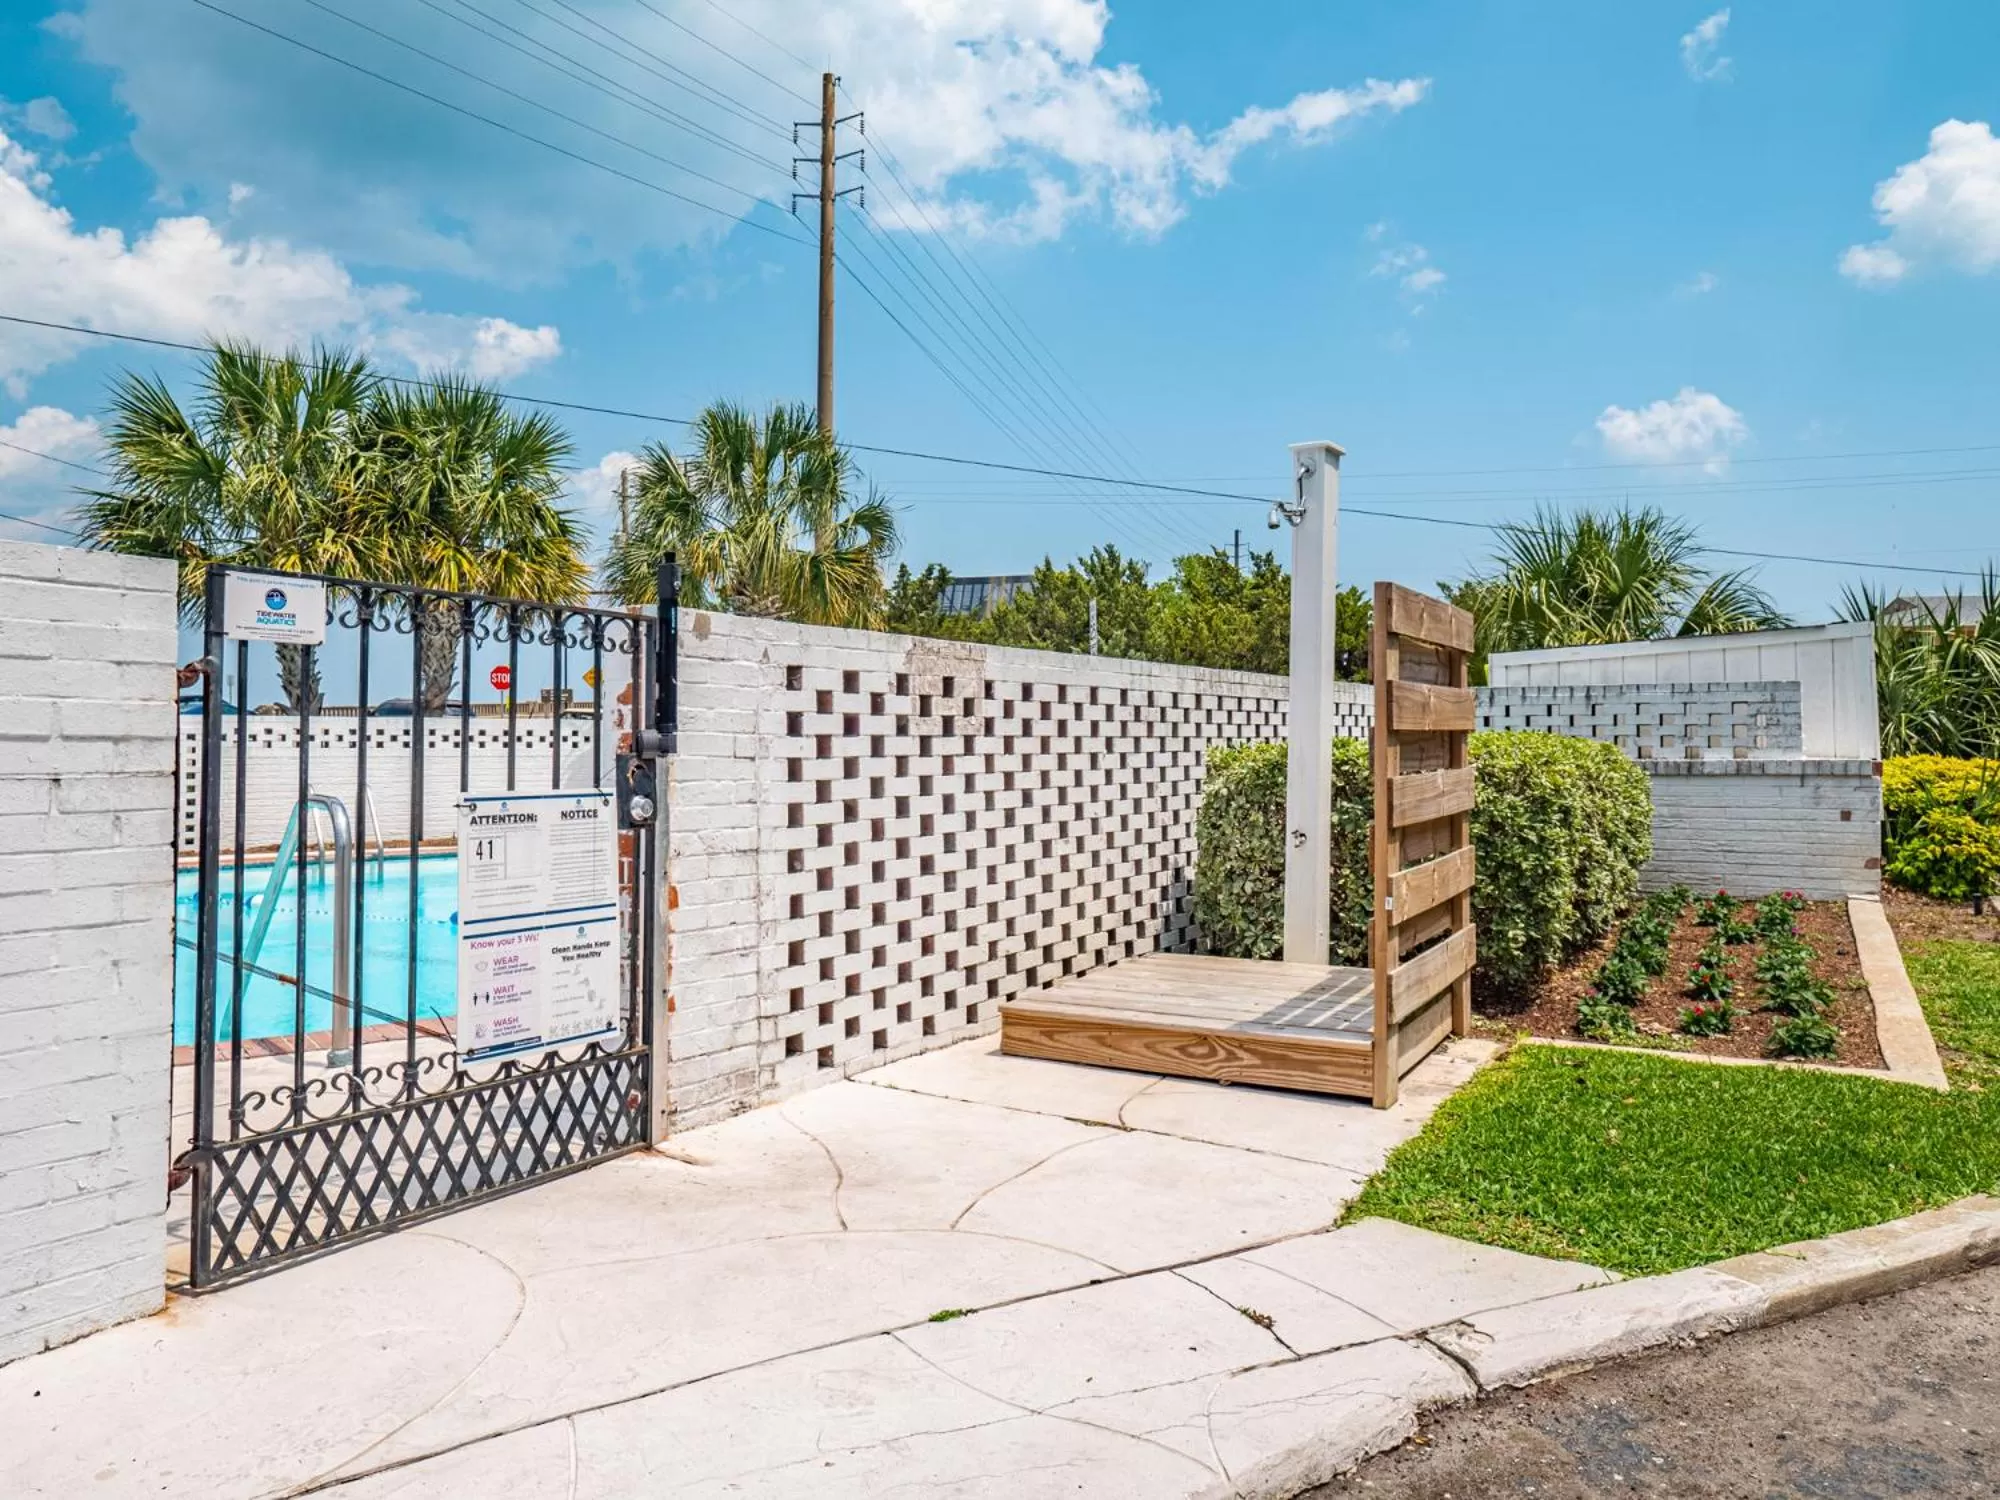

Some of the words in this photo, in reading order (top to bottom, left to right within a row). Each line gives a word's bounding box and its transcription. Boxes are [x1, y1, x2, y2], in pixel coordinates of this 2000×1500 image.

[256, 610, 296, 619] TIDEWATER
[256, 617, 296, 626] AQUATICS
[470, 813, 538, 826] ATTENTION:
[560, 809, 598, 820] NOTICE
[470, 940, 495, 950] Know
[493, 955, 519, 966] WEAR
[493, 984, 514, 994] WAIT
[493, 1016, 519, 1027] WASH
